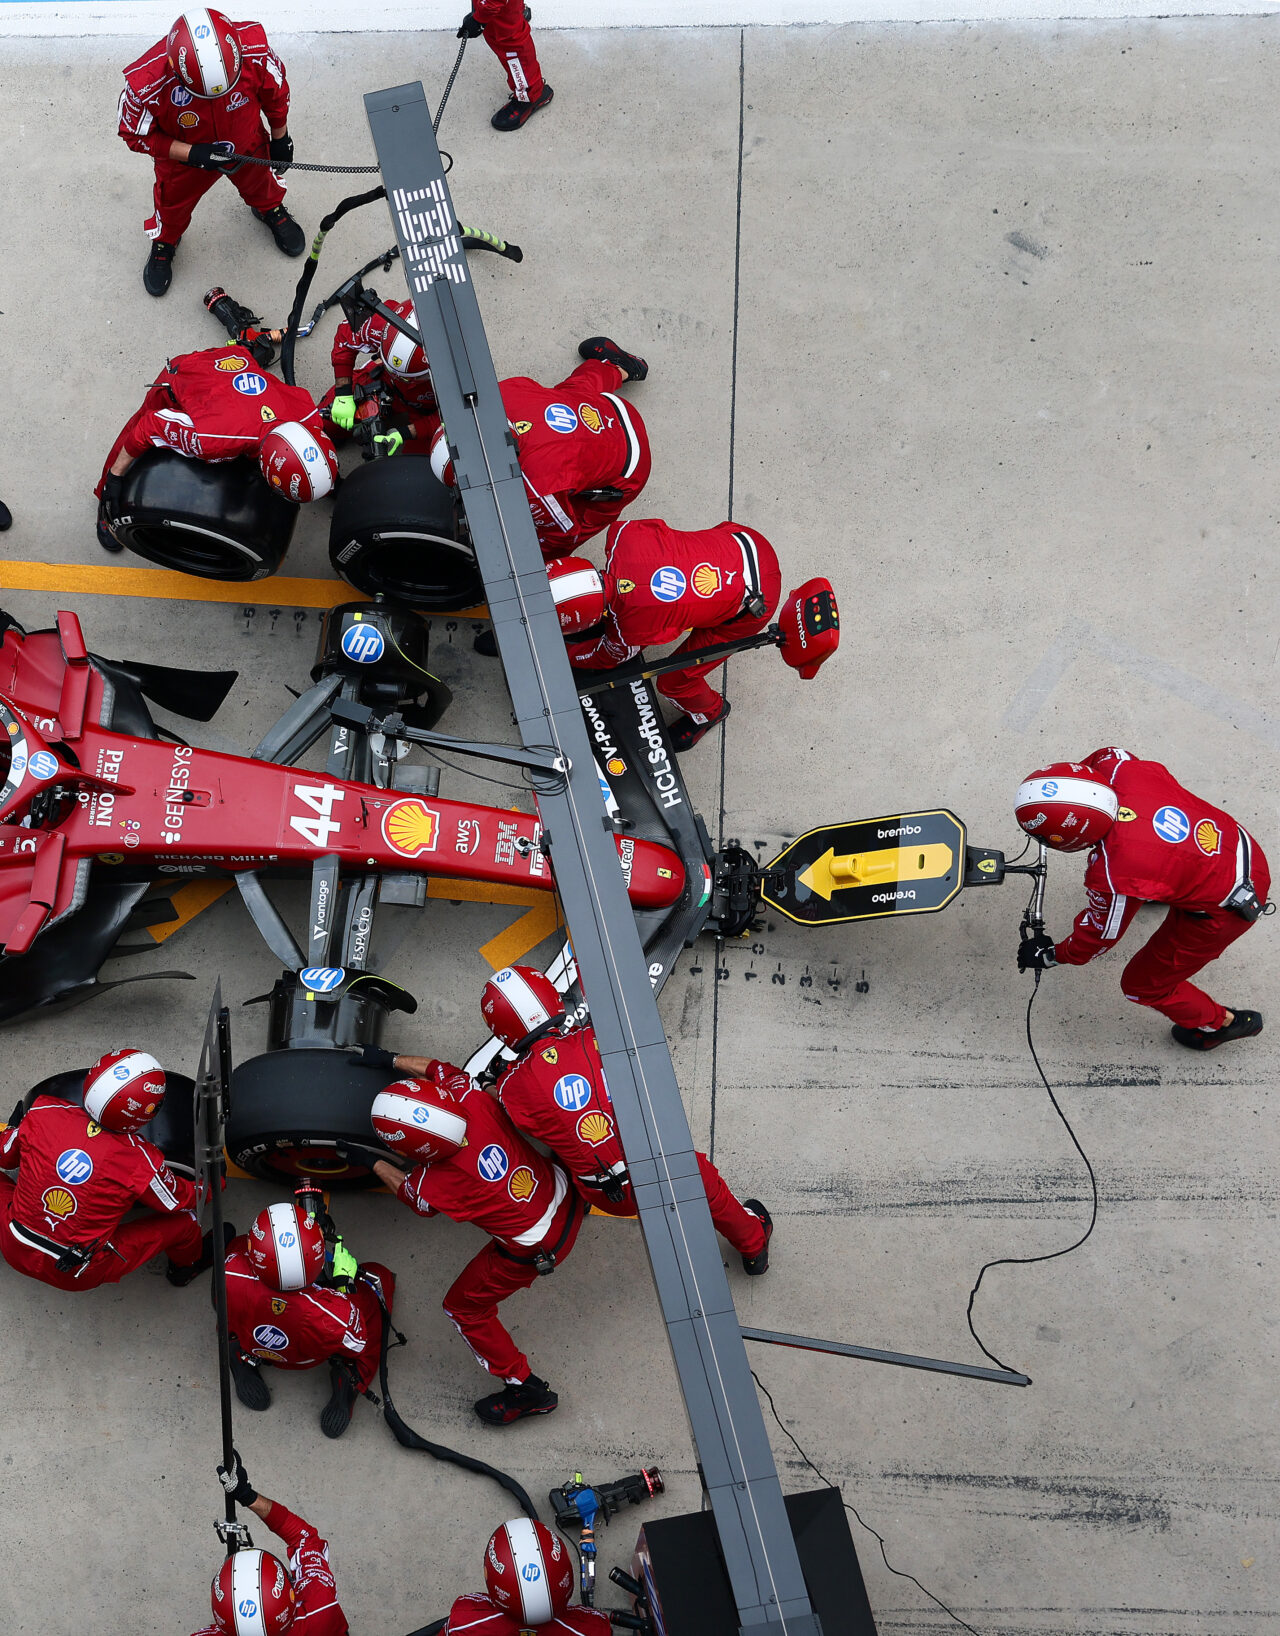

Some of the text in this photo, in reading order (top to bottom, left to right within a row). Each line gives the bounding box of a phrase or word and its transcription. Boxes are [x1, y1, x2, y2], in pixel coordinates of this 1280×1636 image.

[195, 25, 210, 39] hp
[393, 179, 466, 293] IBM
[236, 374, 263, 394] hp
[547, 405, 574, 433] hp
[304, 447, 318, 462] hp
[337, 539, 362, 564] PIRELLI
[653, 568, 683, 601] hp
[796, 598, 808, 649] brembo
[347, 625, 382, 662] hp
[629, 679, 682, 809] HCLSoftwar
[29, 753, 58, 777] hp
[164, 746, 193, 829] GENESYS
[1042, 782, 1058, 797] hp
[88, 792, 98, 826] AZZURRO
[290, 784, 345, 848] 44
[455, 819, 470, 854] aws
[877, 824, 921, 839] brembo
[1154, 807, 1187, 842] hp
[495, 821, 518, 866] IBM
[154, 853, 279, 863] RICHARD MILLE
[318, 880, 329, 924] vantage
[872, 890, 916, 903] brembo
[353, 907, 371, 961] ESPACIO
[304, 967, 341, 992] hp
[497, 971, 511, 982] hp
[772, 973, 786, 986] 2
[114, 1066, 130, 1080] hp
[559, 1075, 586, 1110] hp
[413, 1107, 429, 1123] hp
[59, 1150, 90, 1183] hp
[481, 1145, 506, 1180] hp
[279, 1232, 295, 1248] hp
[256, 1326, 285, 1349] hp
[522, 1563, 540, 1581] hp
[239, 1600, 257, 1617] hp
